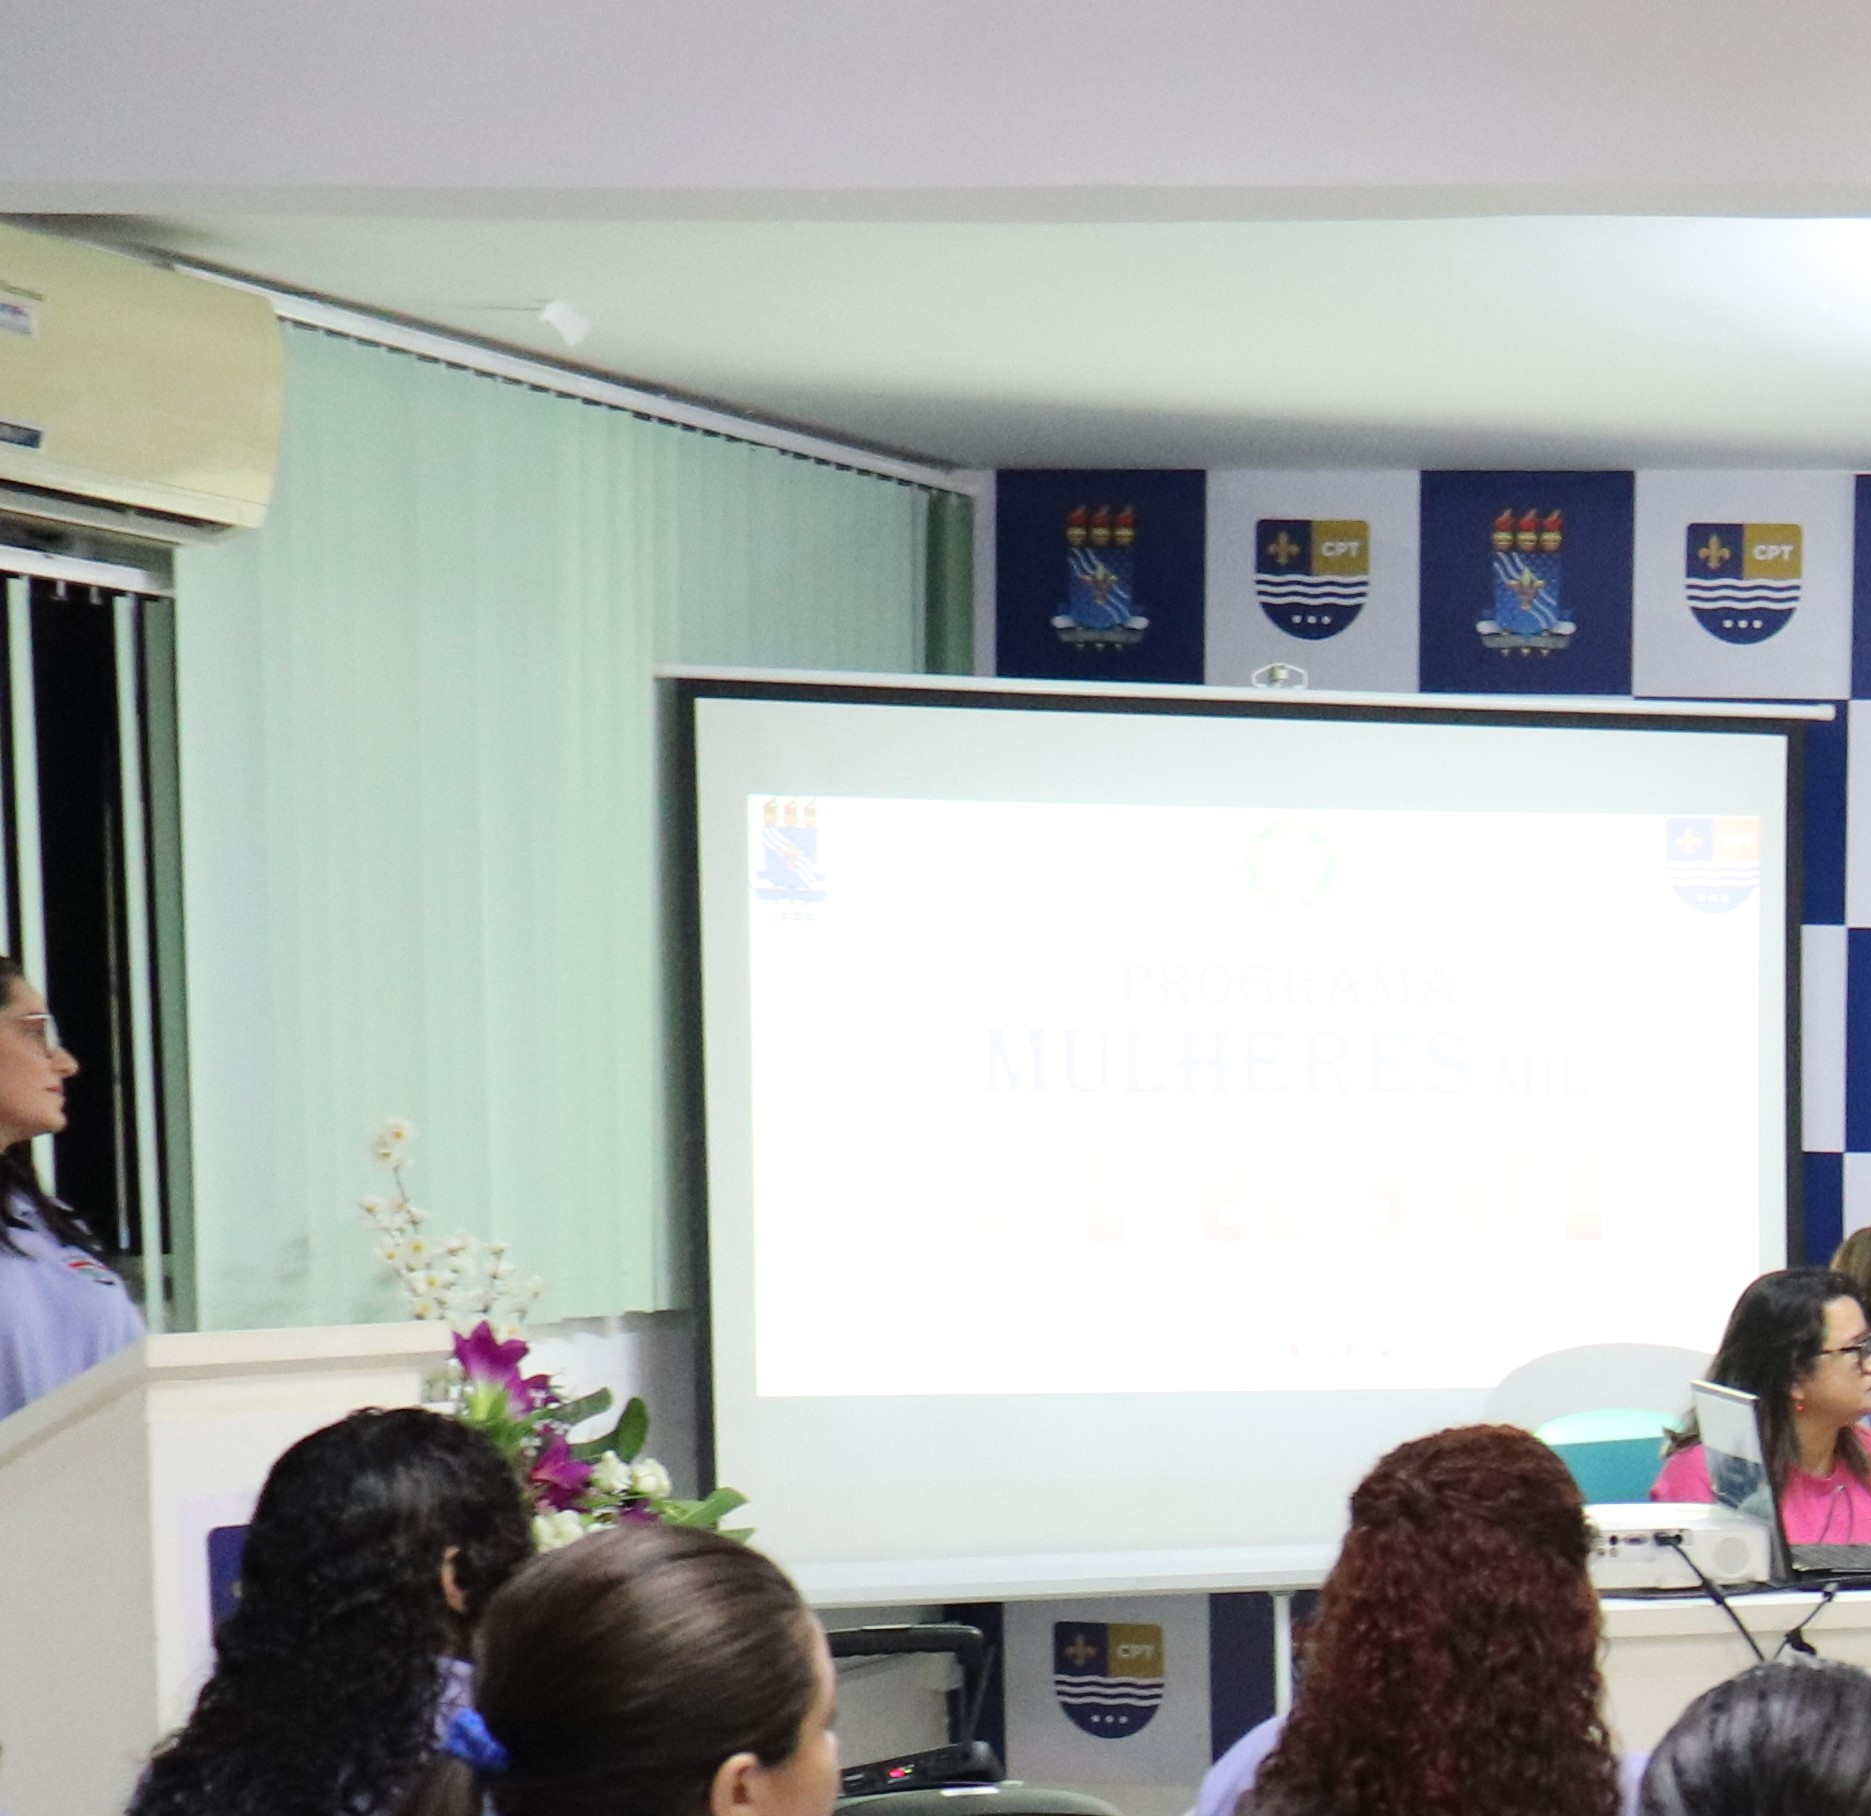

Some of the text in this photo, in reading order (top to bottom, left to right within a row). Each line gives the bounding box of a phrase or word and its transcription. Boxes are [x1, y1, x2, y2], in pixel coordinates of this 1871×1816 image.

[1321, 541, 1360, 556] CPT
[1753, 544, 1793, 560] CPT
[983, 1028, 1474, 1095] MULHERES
[1116, 1644, 1154, 1658] CPT
